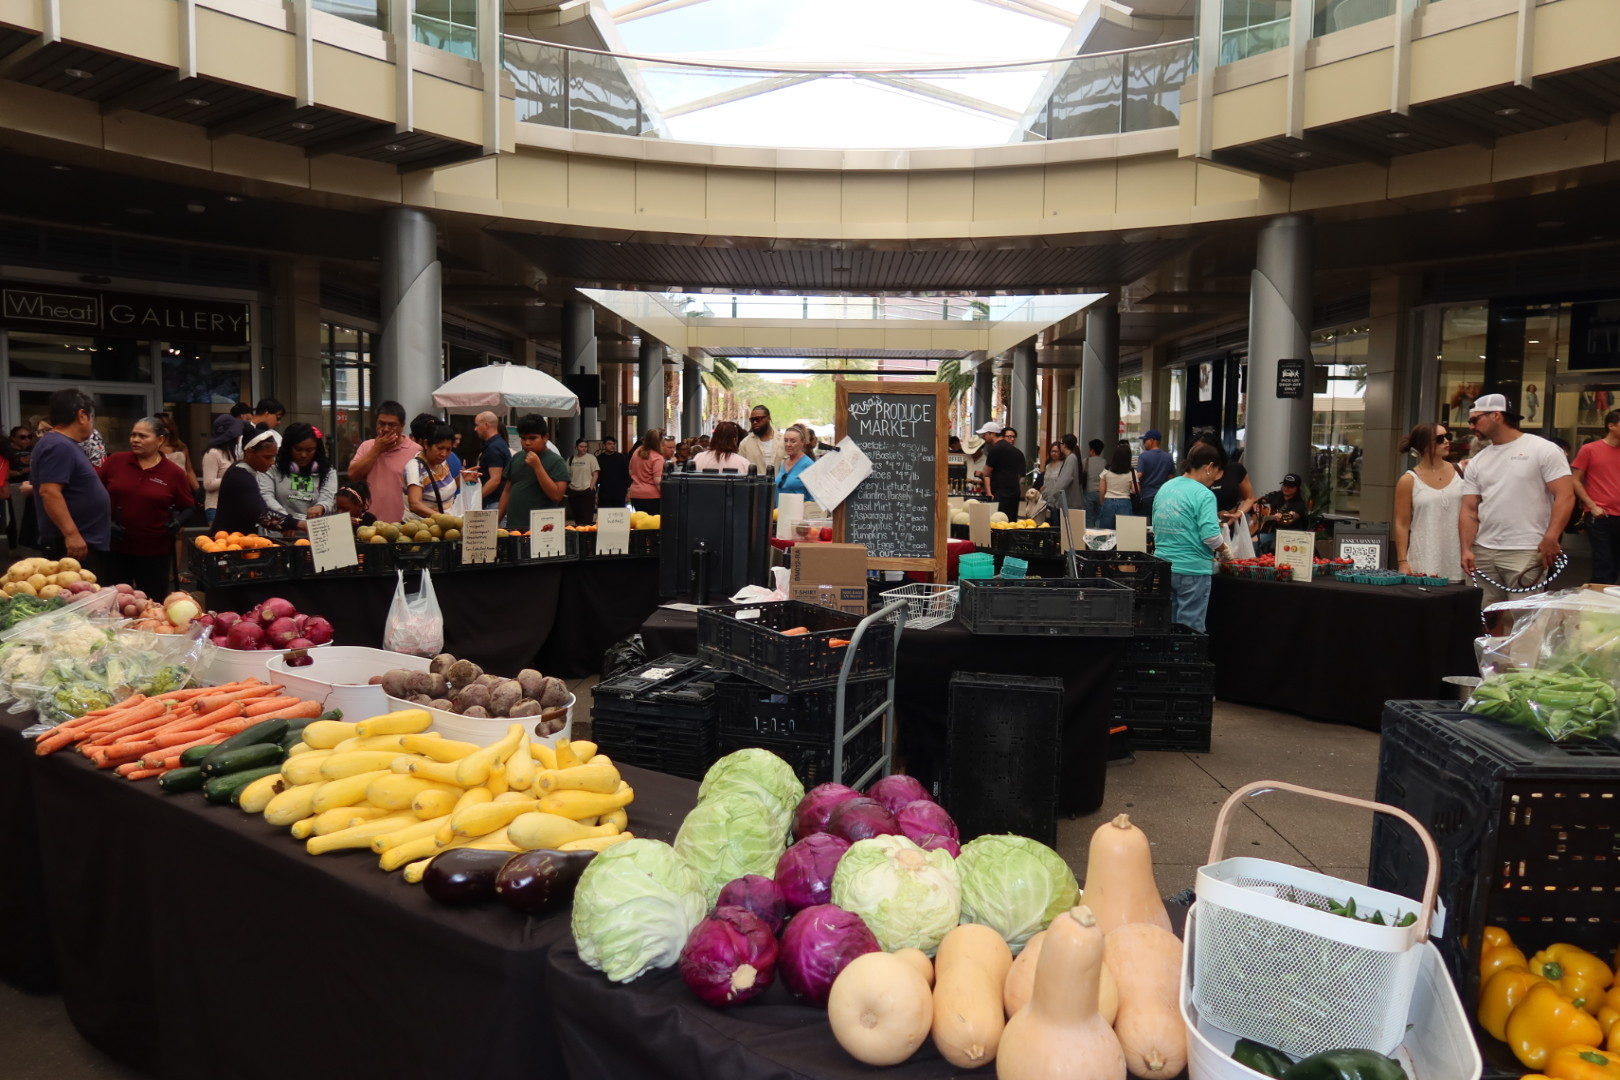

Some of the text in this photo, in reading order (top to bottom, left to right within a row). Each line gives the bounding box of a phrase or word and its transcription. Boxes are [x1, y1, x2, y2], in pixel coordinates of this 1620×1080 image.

[8, 294, 242, 333] Wheat GALLERY
[875, 402, 931, 423] PRODUCE
[860, 420, 918, 438] MARKET
[853, 511, 894, 521] Asparagus
[853, 520, 893, 532] Eucalyptus
[911, 524, 928, 532] each
[853, 529, 888, 539] Pumpkins
[877, 540, 895, 550] Eggs
